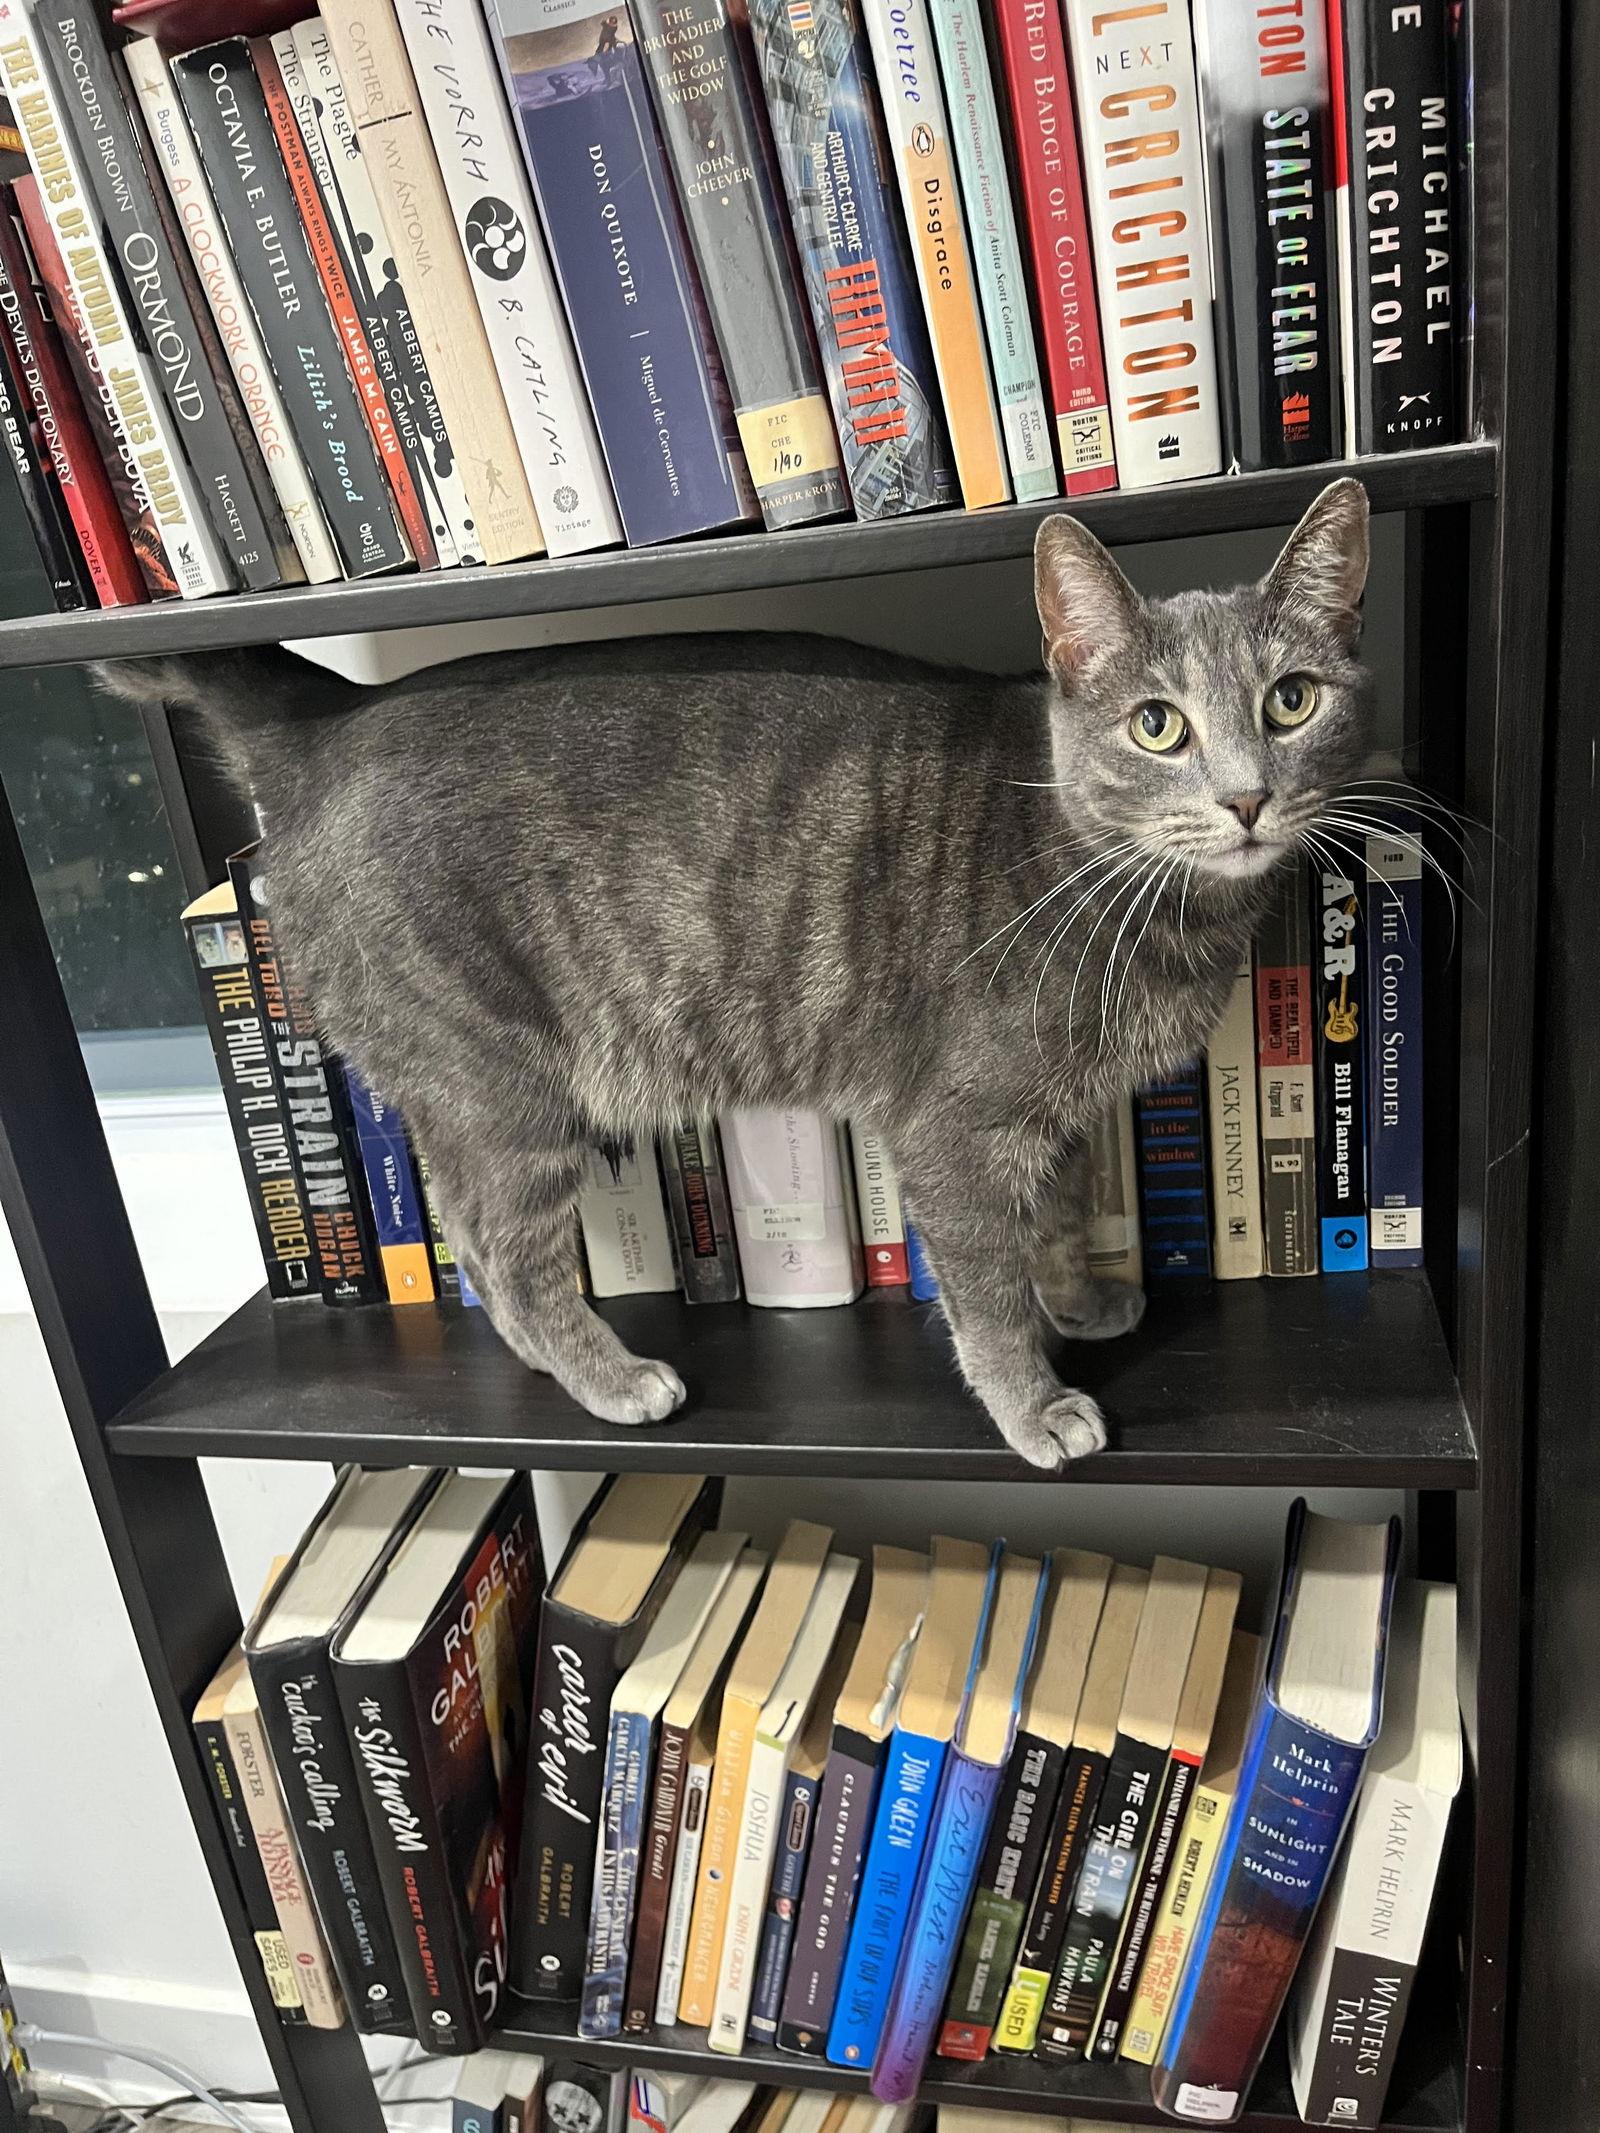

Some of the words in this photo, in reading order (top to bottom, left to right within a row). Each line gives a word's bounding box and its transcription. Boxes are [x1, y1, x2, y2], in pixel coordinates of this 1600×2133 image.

[643, 17, 723, 54] BRIGADIER
[663, 6, 694, 26] THE
[952, 13, 962, 43] The
[1024, 2, 1047, 62] RED
[3, 36, 38, 88] THE
[658, 67, 688, 89] THE
[690, 56, 728, 79] GOLF
[672, 45, 705, 65] AND
[956, 41, 971, 89] Harlem
[1097, 42, 1173, 75] NEXT
[58, 18, 108, 131] BROCKDEN
[98, 135, 133, 213] BROWN
[310, 33, 333, 77] The
[326, 82, 358, 161] Plague
[349, 21, 384, 105] CATHER
[382, 139, 405, 172] MY
[667, 77, 725, 105] WIDOW
[157, 108, 180, 166] Burgess
[279, 44, 301, 88] The
[296, 94, 335, 193] Stranger
[434, 64, 488, 182] VORRH
[1034, 74, 1063, 175] BADGE
[16, 90, 77, 204] MARINES
[695, 153, 735, 179] JOHN
[810, 142, 829, 171] AND
[1262, 107, 1313, 226] STATE
[208, 62, 256, 182] OCTAVIA
[247, 185, 265, 208] E.
[256, 215, 300, 319] BUTLER
[267, 78, 276, 101] THE
[275, 102, 303, 172] POSTMAN
[297, 173, 315, 218] ALWAYS
[312, 219, 328, 254] RINGS
[324, 255, 345, 300] TWICE
[688, 168, 752, 198] CHEEVER
[817, 172, 838, 223] GENTRY
[980, 175, 993, 216] Fiction
[1049, 187, 1068, 222] OF
[56, 208, 89, 240] OF
[588, 144, 611, 195] DON
[600, 203, 637, 306] QUIXOTE
[827, 223, 843, 250] LEE
[840, 201, 863, 253] CLARKE
[925, 179, 951, 290] Disgrace
[987, 220, 998, 232] of
[1363, 87, 1402, 364] CRICHTON
[1420, 97, 1450, 345] MICHAEL
[990, 236, 1001, 270] Anita
[1099, 83, 1200, 422] CRICHTON
[1276, 236, 1308, 267] OF
[68, 246, 124, 347] AUTUMN
[498, 299, 523, 320] B.
[996, 273, 1007, 302] Scott
[1055, 236, 1086, 371] COURAGE
[124, 232, 204, 422] ORMOND
[172, 177, 191, 194] A
[183, 202, 248, 355] CLOCKWORK
[239, 364, 285, 461] ORANGE
[1001, 305, 1016, 357] Coleman
[1271, 282, 1318, 376] FEAR
[342, 314, 371, 378] JAMES
[365, 382, 379, 404] M.
[373, 408, 398, 455] CAIN
[366, 316, 398, 382] ALBERT
[391, 387, 417, 449] CAMUS
[395, 308, 427, 376] ALBERT
[419, 381, 447, 443] CAMUS
[640, 355, 662, 405] Miguel
[1003, 379, 1036, 397] CHAMPION
[1072, 386, 1092, 398] THIRD
[109, 367, 157, 446] JAMES
[297, 344, 338, 430] Lilith's
[329, 439, 363, 503] Brood
[653, 408, 665, 425] de
[767, 413, 788, 427] FIC
[1069, 395, 1096, 408] EDITION
[1072, 415, 1098, 427] NORTON
[1387, 416, 1444, 434] KNOPF
[4, 418, 30, 474] BEAR
[26, 368, 75, 487] DICTIONARY
[771, 436, 791, 449] CHE
[1019, 412, 1036, 462] COLEMAN
[658, 429, 680, 497] Cervantes
[138, 449, 186, 528] BRADY
[215, 474, 246, 543] HACKETT
[298, 523, 317, 558] NORTON
[554, 518, 591, 533] Vintage
[81, 530, 102, 575] DOVER
[238, 551, 259, 566] 4125
[1383, 853, 1404, 863] FORD
[1323, 873, 1356, 981] A&R
[1382, 895, 1404, 944] THE
[213, 967, 255, 1012] THE
[1383, 954, 1405, 1022] GOOD
[223, 1016, 273, 1085] PHILIP
[1216, 1065, 1241, 1115] JACK
[1335, 1062, 1351, 1101] Bill
[1382, 1031, 1405, 1126] SOLDIER
[276, 1039, 350, 1206] STRAIN
[1151, 1122, 1164, 1134] in
[1166, 1123, 1190, 1134] the
[382, 1154, 399, 1192] White
[1145, 1149, 1196, 1162] window
[1224, 1121, 1244, 1199] FINNEY
[1333, 1105, 1352, 1200] Flanagan
[261, 1178, 311, 1261] READER
[389, 1194, 406, 1228] Noise
[616, 1207, 630, 1245] CONAN
[870, 1185, 890, 1236] HOUSE
[313, 1213, 341, 1279] HOGAN
[334, 1211, 366, 1278] CHUCK
[444, 1514, 523, 1662] ROBERT
[236, 1731, 265, 1798] FORSTER
[662, 1730, 683, 1769] JOHN
[900, 1751, 932, 1797] JOHN
[1021, 1749, 1047, 1787] THE
[1288, 1742, 1332, 1774] Mark
[1126, 1770, 1150, 1807] THE
[1272, 1756, 1339, 1795] Helprin
[654, 1772, 678, 1833] GARDNER
[744, 1788, 770, 1861] JOSHUA
[830, 1773, 854, 1867] CLAUDIUS
[889, 1797, 920, 1849] GREEN
[1006, 1789, 1037, 1844] BASIC
[1066, 1805, 1081, 1832] ELLEN
[1287, 1816, 1298, 1826] IN
[1092, 1823, 1116, 1859] THE
[1113, 1809, 1139, 1851] GIRL
[1248, 1816, 1327, 1855] SUNLIGHT
[1384, 1798, 1413, 1868] MARK
[652, 1833, 668, 1880] Grendel
[1108, 1854, 1127, 1882] ON
[1242, 1857, 1311, 1889] SHADOW
[1264, 1848, 1284, 1863] AND
[1287, 1857, 1299, 1867] IN
[537, 1847, 554, 1925] GALBRAITH
[558, 1862, 574, 1919] ROBERT
[822, 1873, 837, 1909] THE
[927, 1862, 970, 1945] West
[1076, 1863, 1105, 1918] TRAIN
[1370, 1867, 1401, 1941] HELPRIN
[273, 1939, 288, 1969] USED
[347, 1898, 375, 1967] GALBRAITH
[402, 1866, 424, 1921] ROBERT
[415, 1924, 441, 1997] GALBRAITH
[1052, 1946, 1081, 2014] HAWKINS
[1080, 1938, 1104, 1984] PAULA
[1007, 1997, 1028, 2036] USED
[1330, 1997, 1364, 2046] TALE
[1356, 1976, 1401, 2077] WINTER'S
